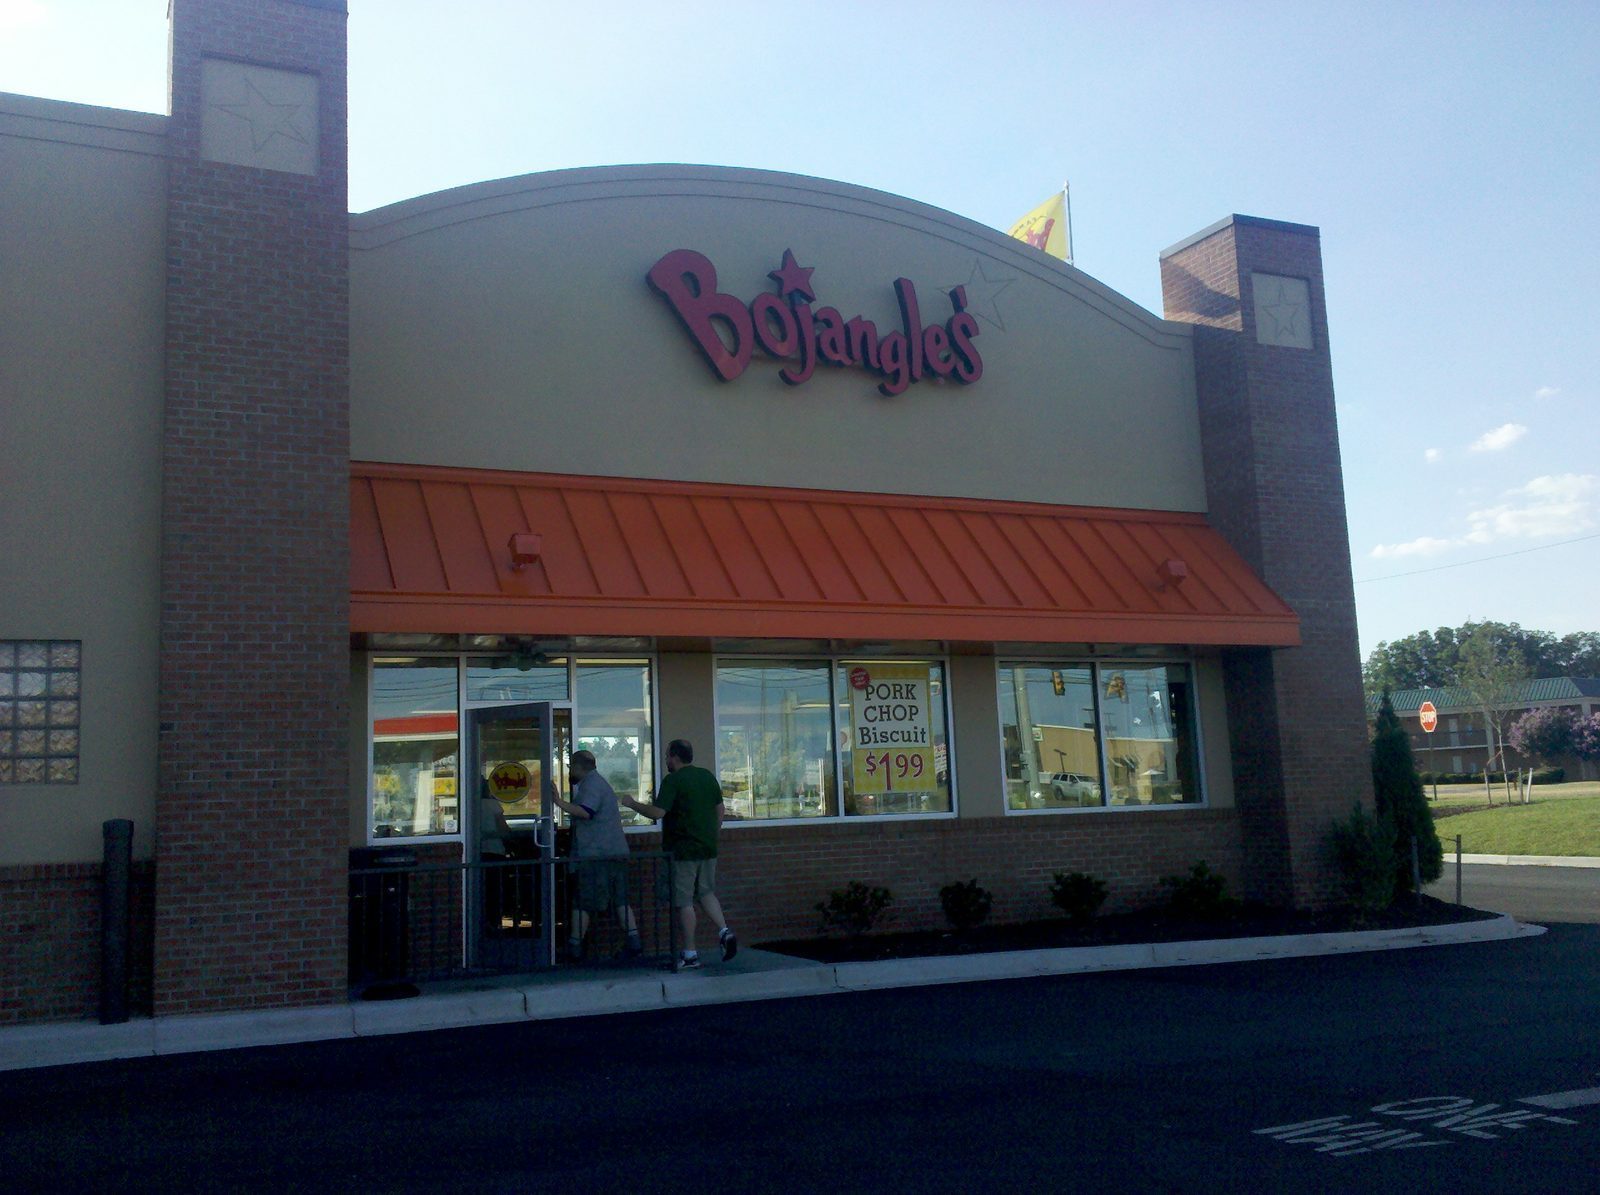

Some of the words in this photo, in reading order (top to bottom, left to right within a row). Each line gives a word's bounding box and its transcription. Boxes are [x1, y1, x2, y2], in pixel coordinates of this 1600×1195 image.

[865, 683, 917, 700] PORK
[865, 704, 919, 722] CHOP
[1421, 711, 1436, 723] STOP
[859, 726, 926, 745] Biscuit
